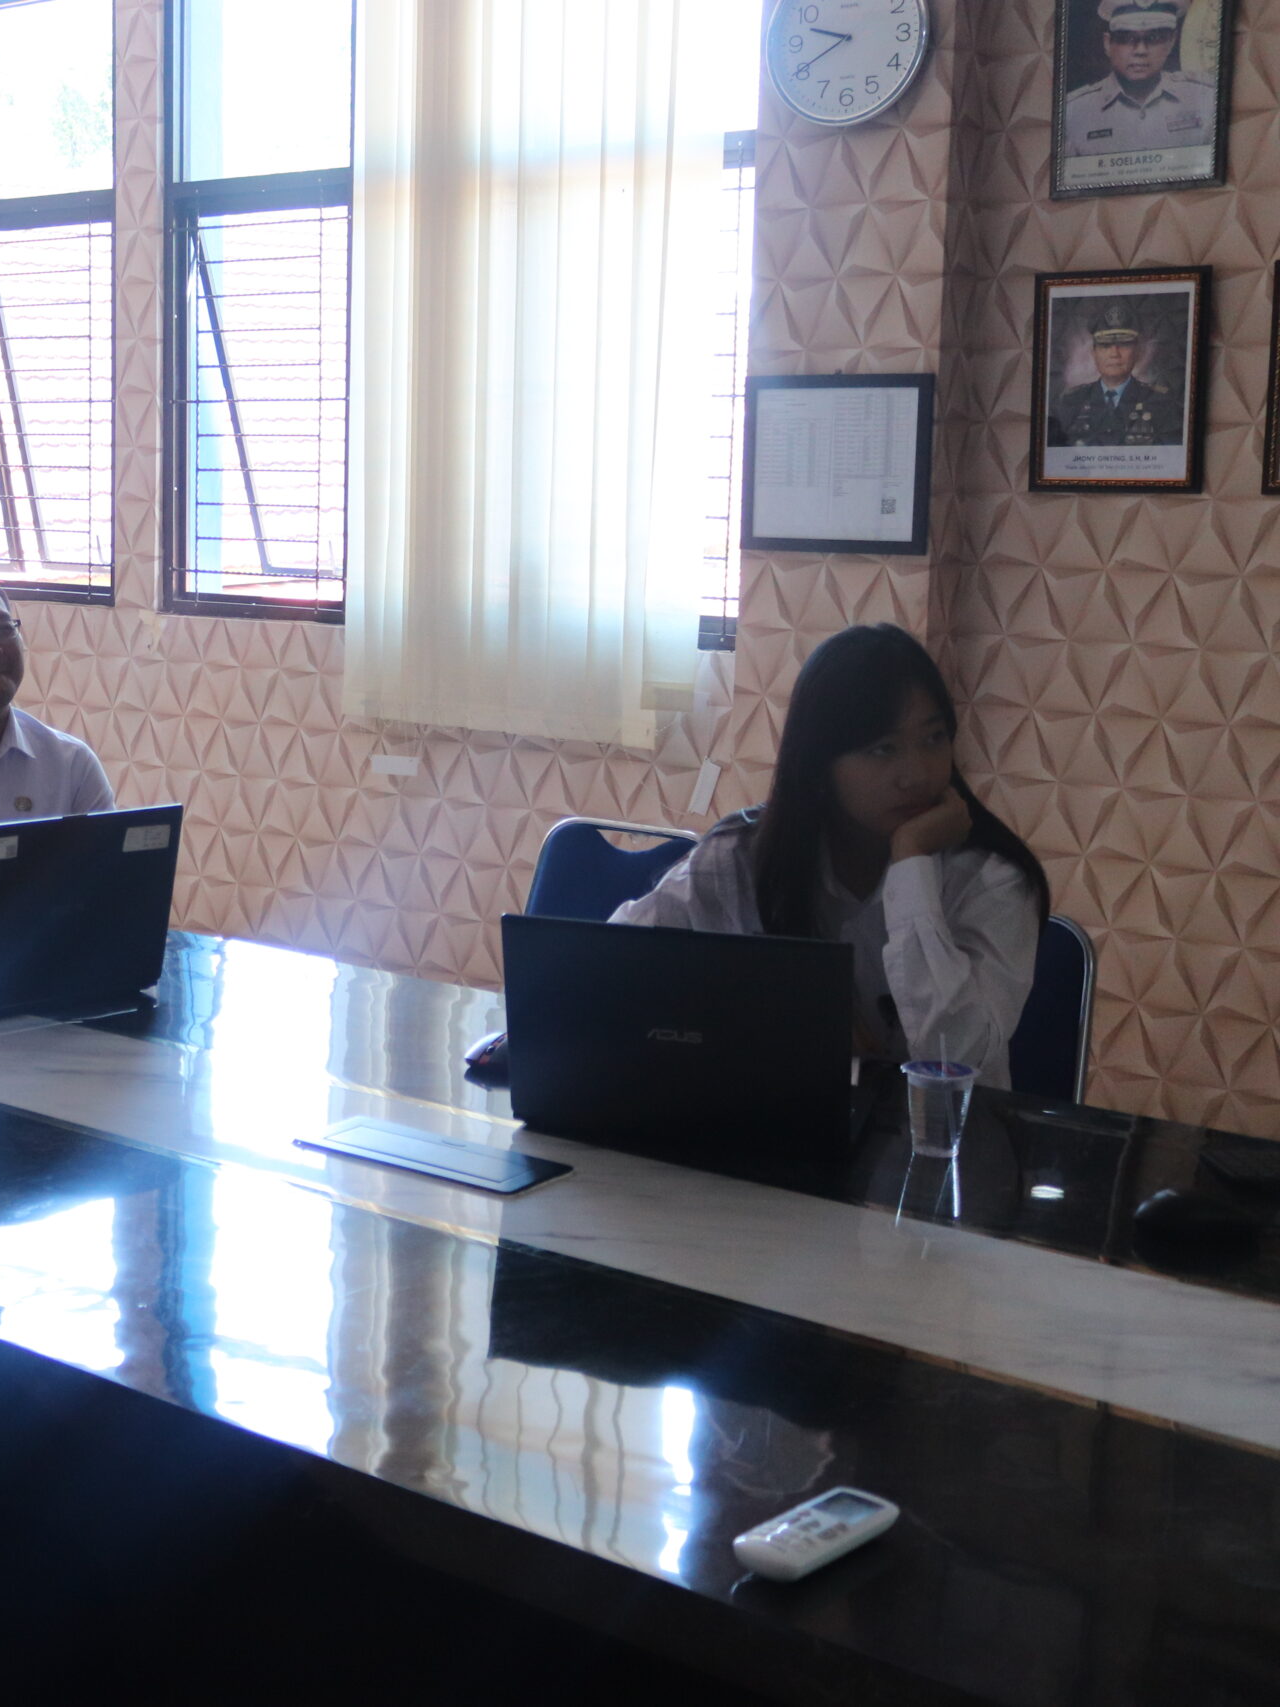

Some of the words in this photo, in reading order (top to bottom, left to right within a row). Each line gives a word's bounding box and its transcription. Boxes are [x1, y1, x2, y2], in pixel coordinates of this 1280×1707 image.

[798, 5, 819, 24] 10
[890, 0, 905, 14] 2
[895, 22, 911, 42] 3
[789, 35, 803, 53] 9
[886, 53, 901, 71] 4
[796, 63, 810, 81] 8
[817, 80, 830, 98] 7
[865, 75, 879, 94] 5
[839, 88, 854, 106] 6
[647, 1028, 703, 1044] ASUS
